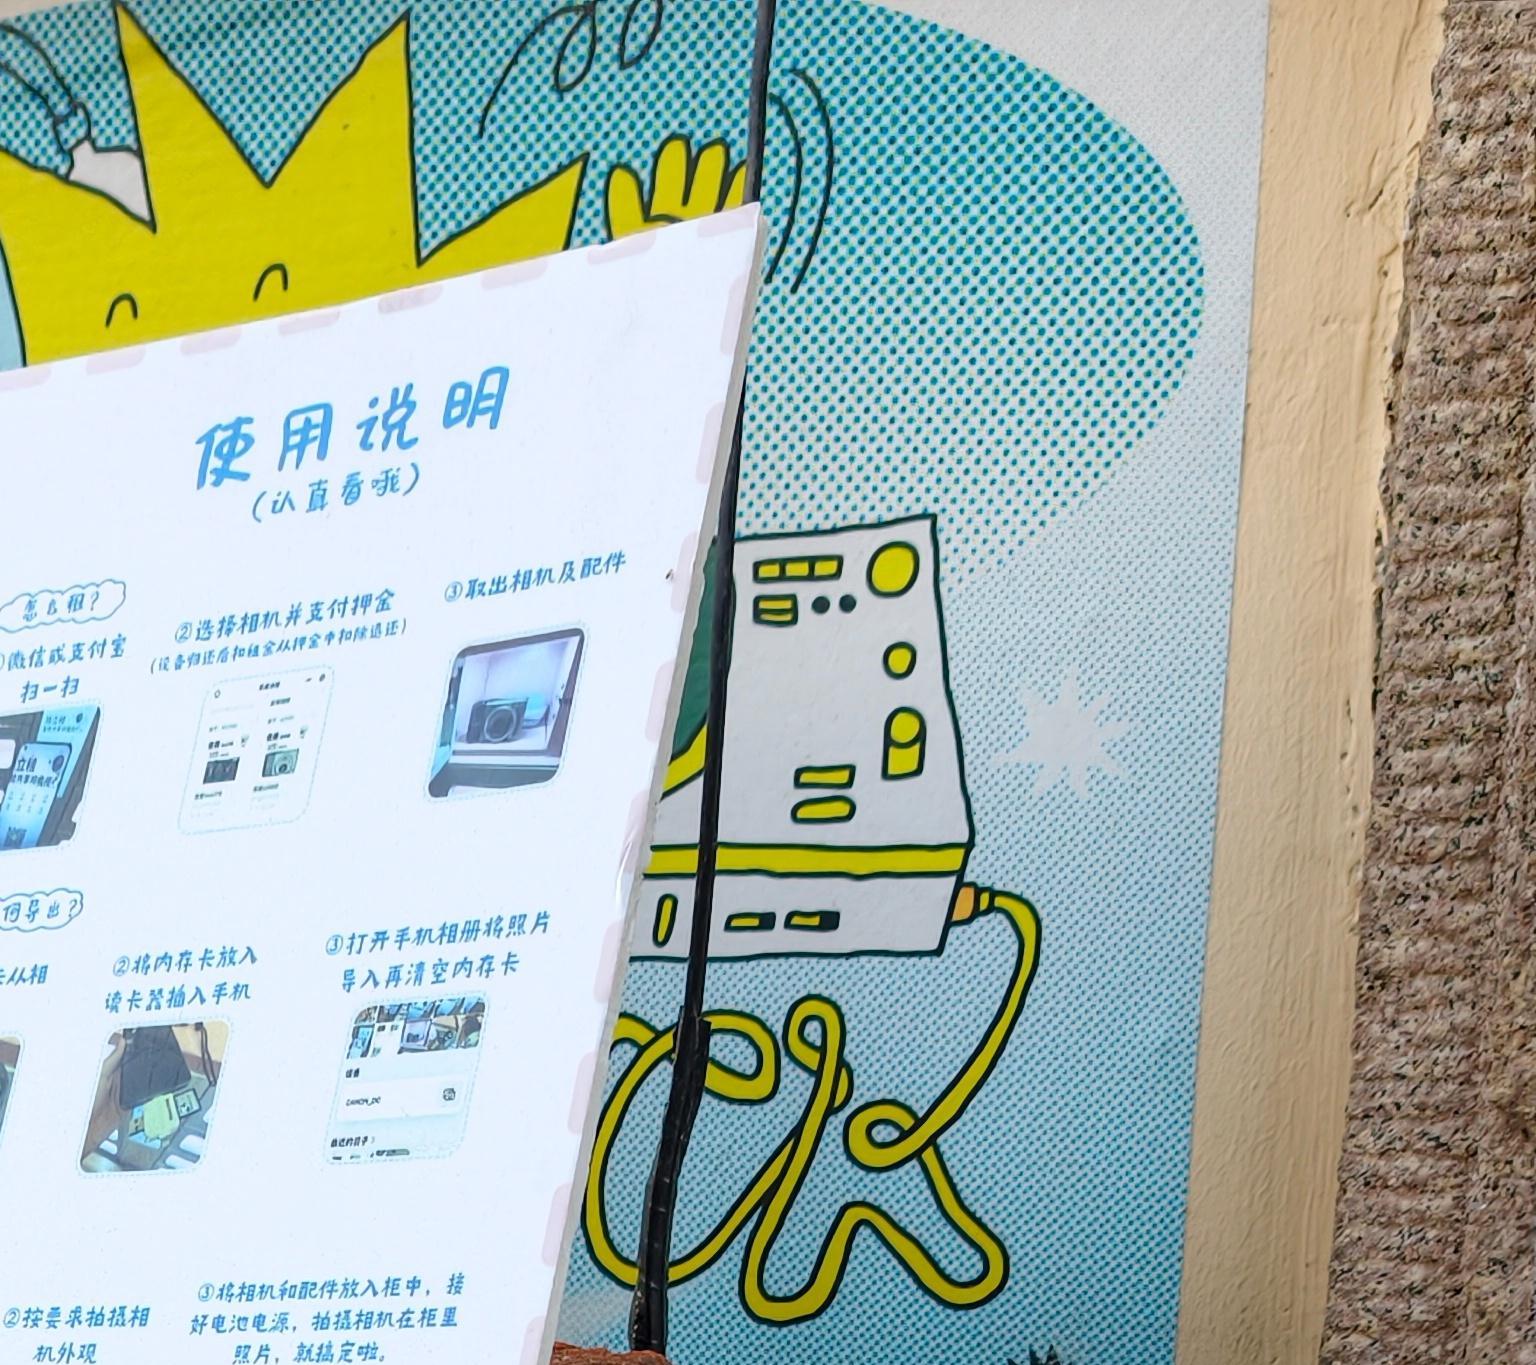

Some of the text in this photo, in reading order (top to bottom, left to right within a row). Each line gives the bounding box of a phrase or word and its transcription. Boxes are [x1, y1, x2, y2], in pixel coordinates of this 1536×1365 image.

[195, 366, 511, 491] 使用说明
[20, 675, 80, 704] 扫一扫
[341, 951, 521, 994] 导入再清空内存卡
[104, 981, 252, 1014] 读卡器插入手机
[32, 1342, 97, 1365] 机外观
